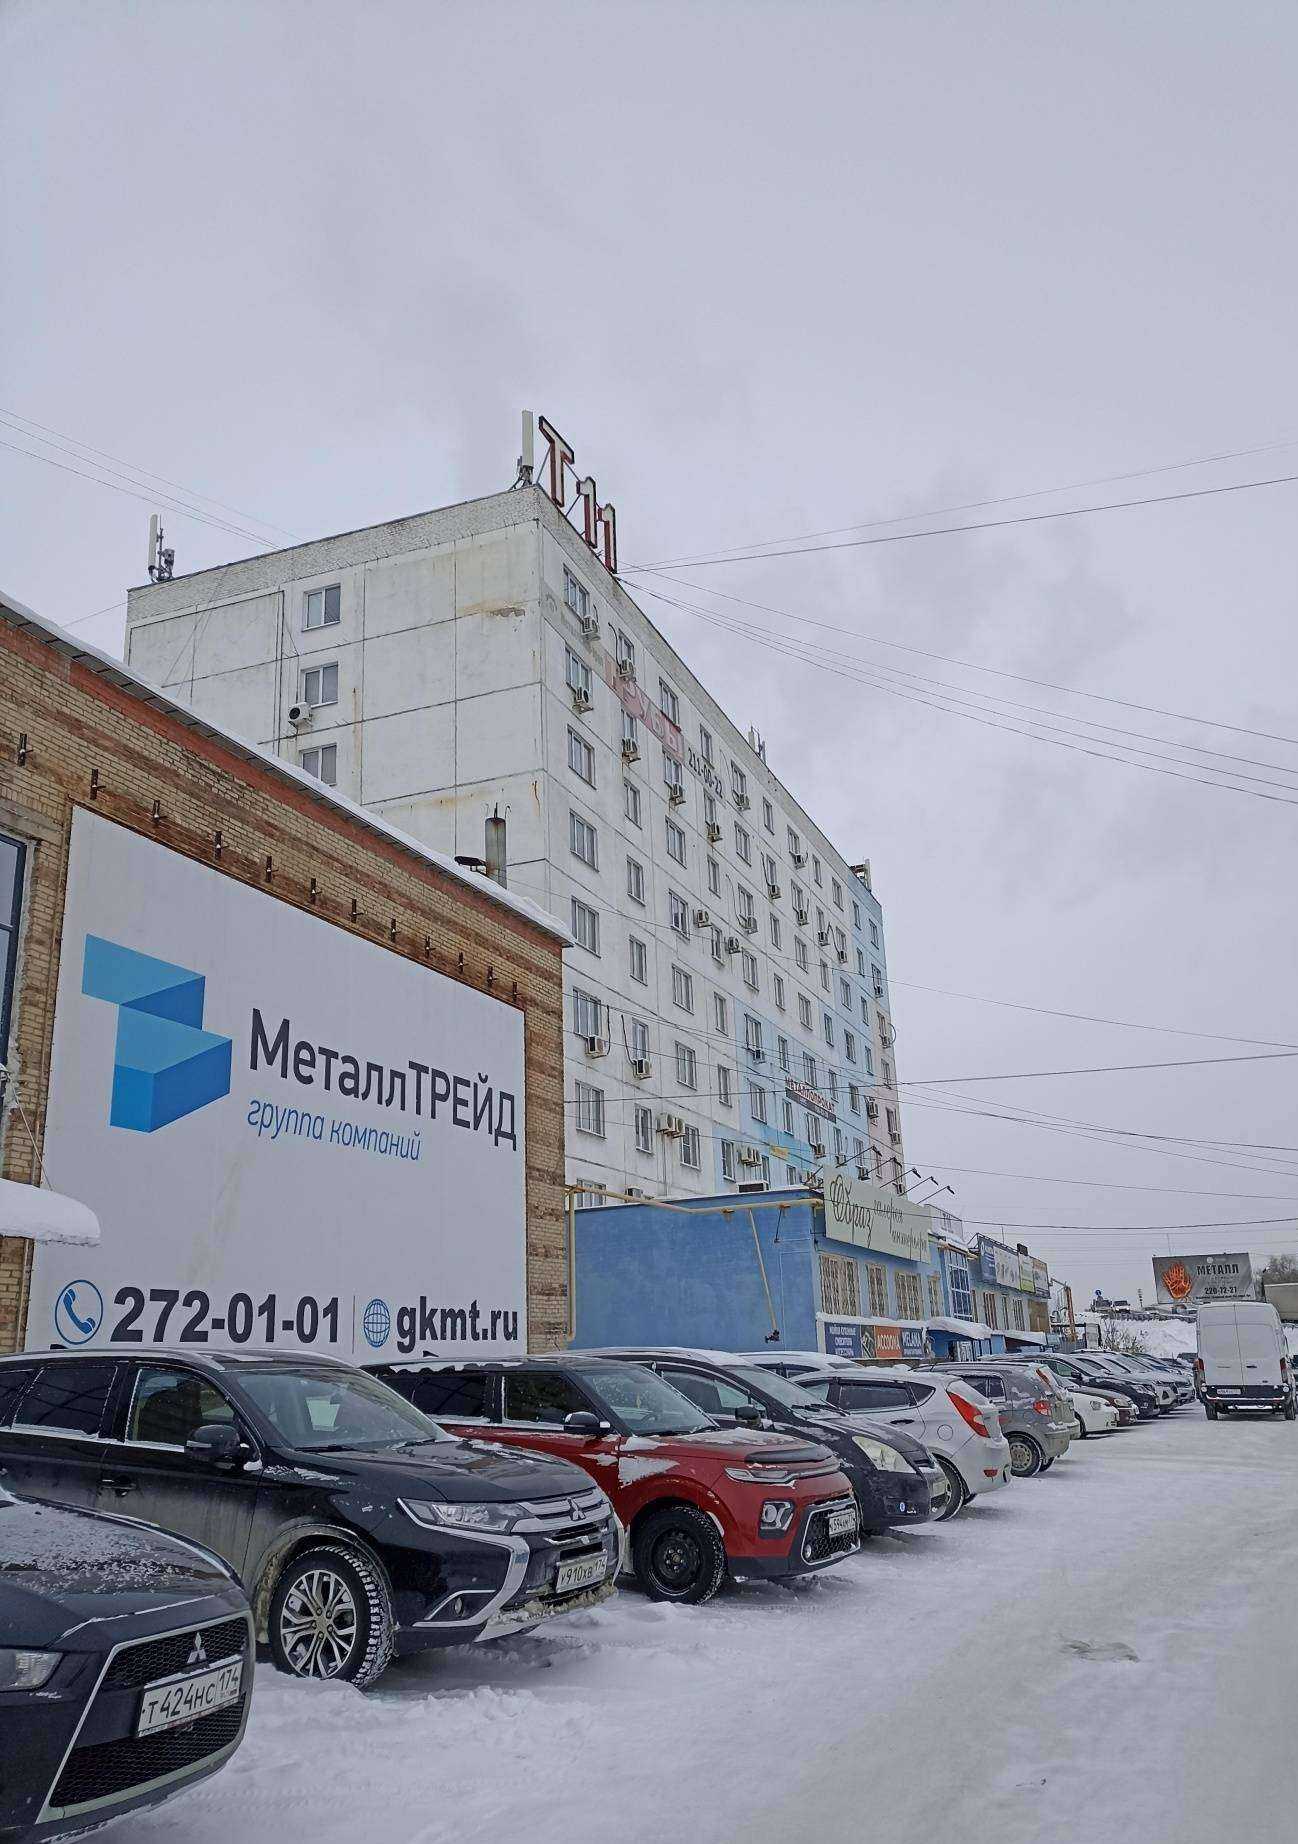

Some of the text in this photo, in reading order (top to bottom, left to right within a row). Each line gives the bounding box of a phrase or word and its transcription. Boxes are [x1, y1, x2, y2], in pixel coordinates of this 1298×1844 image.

[249, 1008, 517, 1151] МеталлТРЕЙД
[247, 1099, 422, 1161] группа компаний
[1196, 1263, 1240, 1276] МЕТАЛЛ
[111, 1286, 518, 1353] 272-01-01 gkmt.ru
